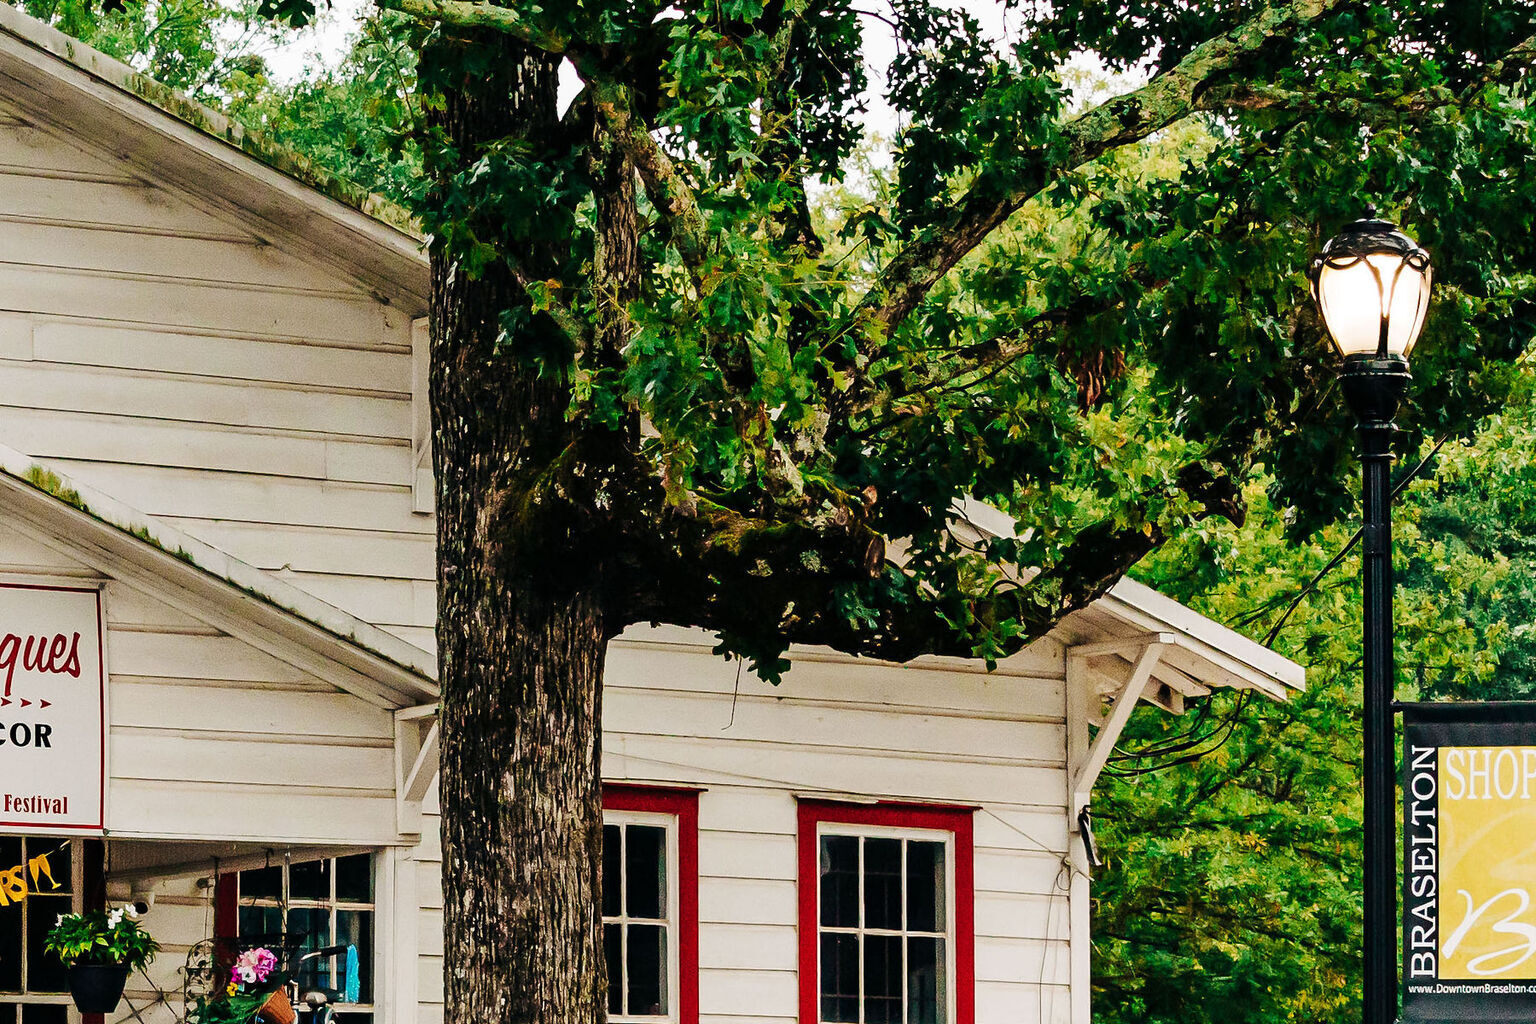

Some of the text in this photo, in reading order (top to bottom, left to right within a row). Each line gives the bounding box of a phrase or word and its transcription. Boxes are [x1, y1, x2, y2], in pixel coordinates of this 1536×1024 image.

[1446, 749, 1536, 800] SHOP
[4, 793, 69, 815] Festival
[1410, 745, 1436, 978] BRASELTON
